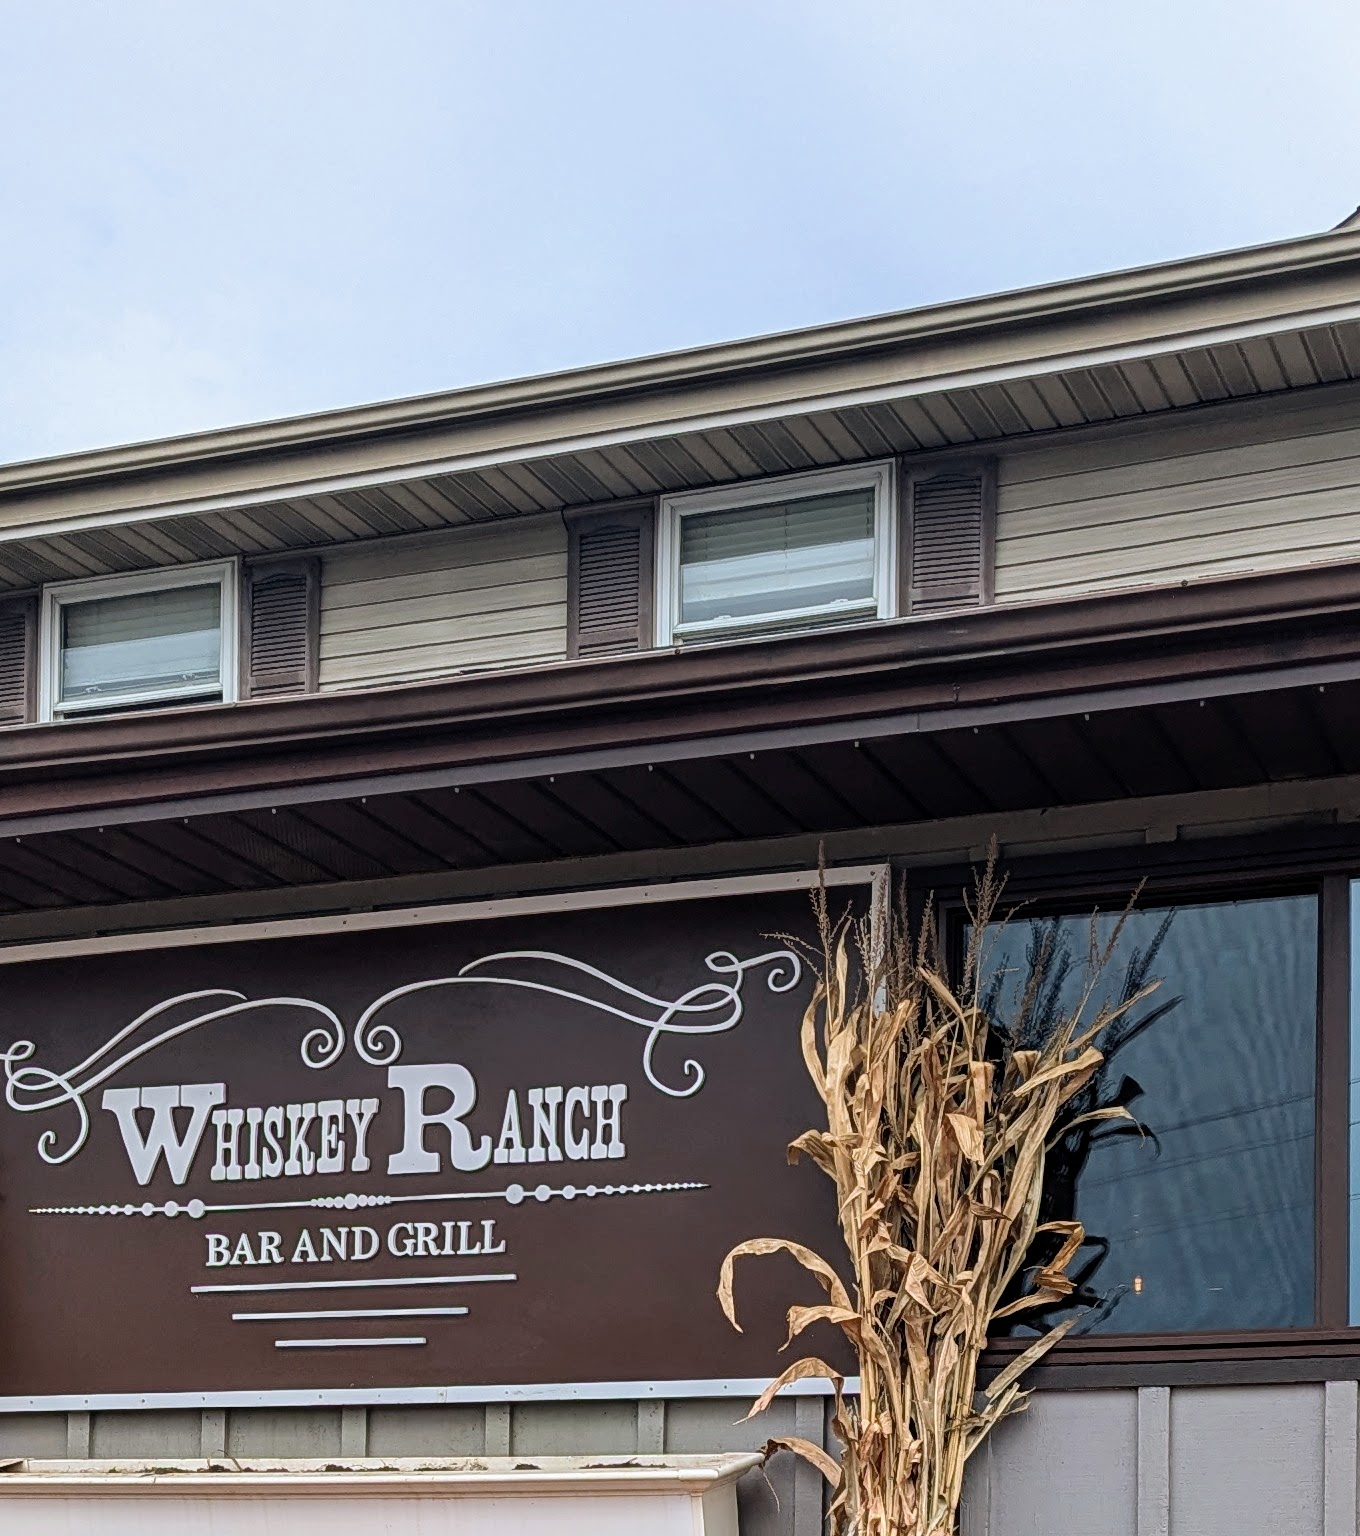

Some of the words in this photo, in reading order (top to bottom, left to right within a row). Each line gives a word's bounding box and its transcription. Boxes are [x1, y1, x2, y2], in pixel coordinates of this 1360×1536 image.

[101, 1082, 380, 1186] WHISKEY
[386, 1063, 628, 1175] RANCH
[204, 1231, 285, 1267] BAR
[291, 1226, 380, 1263] AND
[387, 1219, 506, 1257] GRILL
